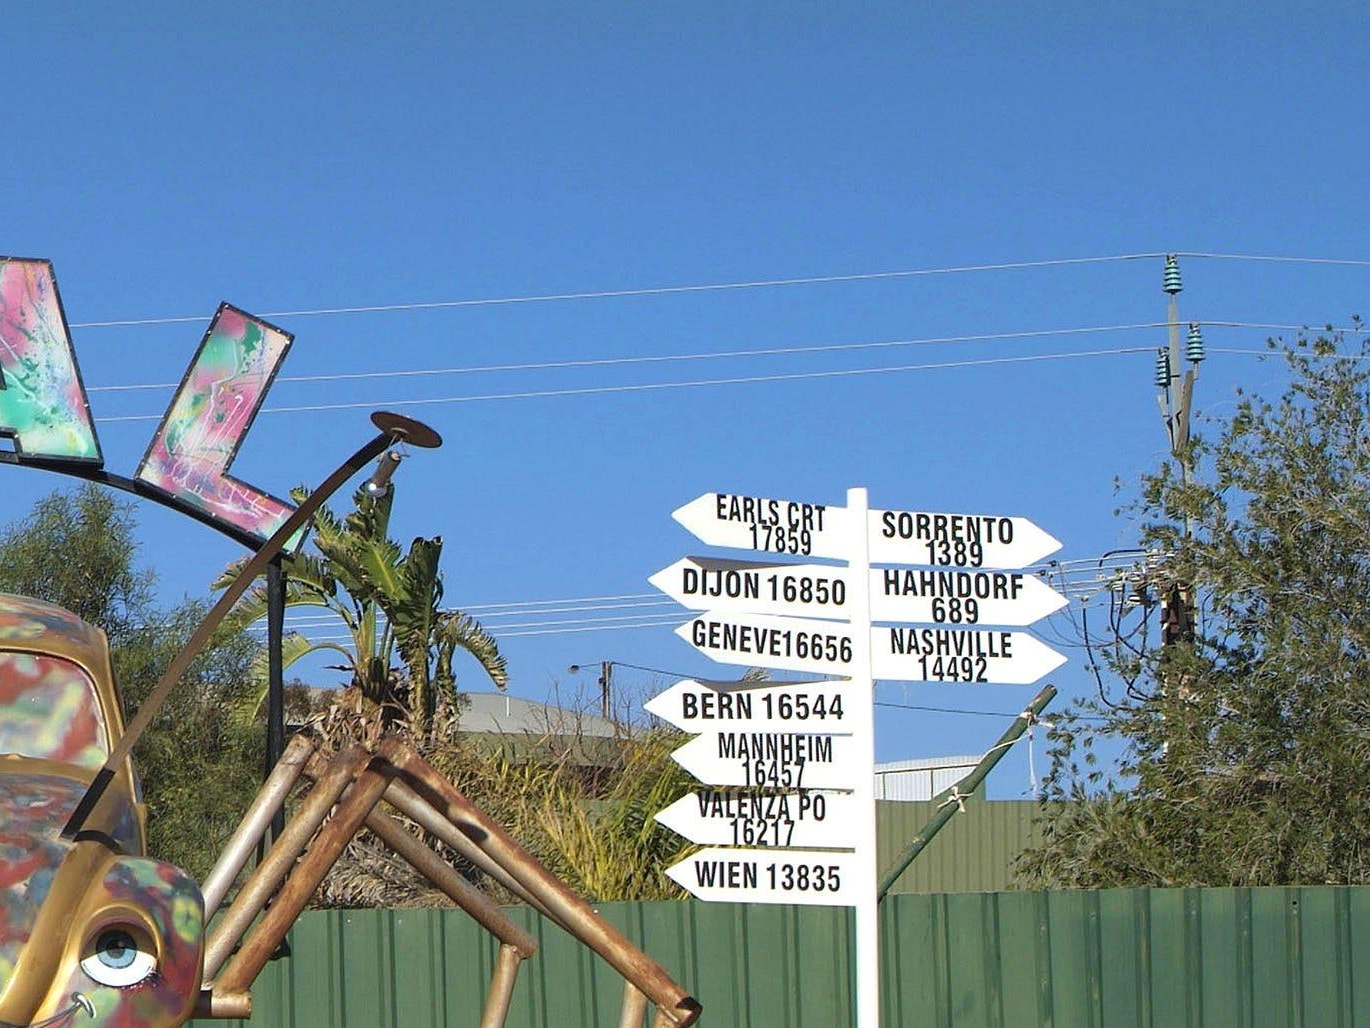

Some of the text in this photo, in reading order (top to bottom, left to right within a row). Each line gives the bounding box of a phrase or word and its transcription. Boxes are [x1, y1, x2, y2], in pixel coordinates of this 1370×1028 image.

[716, 494, 826, 532] EARLS CRT
[882, 511, 1014, 544] SORRENTO
[750, 523, 812, 556] 17859
[926, 539, 983, 568] 1389
[683, 567, 846, 606] DIJON 16850
[884, 569, 1023, 600] HAHNDORF
[931, 597, 979, 625] 689
[890, 628, 1013, 658] NASHVILLE
[918, 655, 988, 683] 14492
[682, 692, 844, 720] BERN 16544
[718, 732, 833, 763] MANNHEIM
[741, 757, 806, 787] 16457
[697, 790, 826, 821] VALENZA PO
[730, 818, 795, 846] 16217
[694, 860, 841, 892] WIEN 13835
